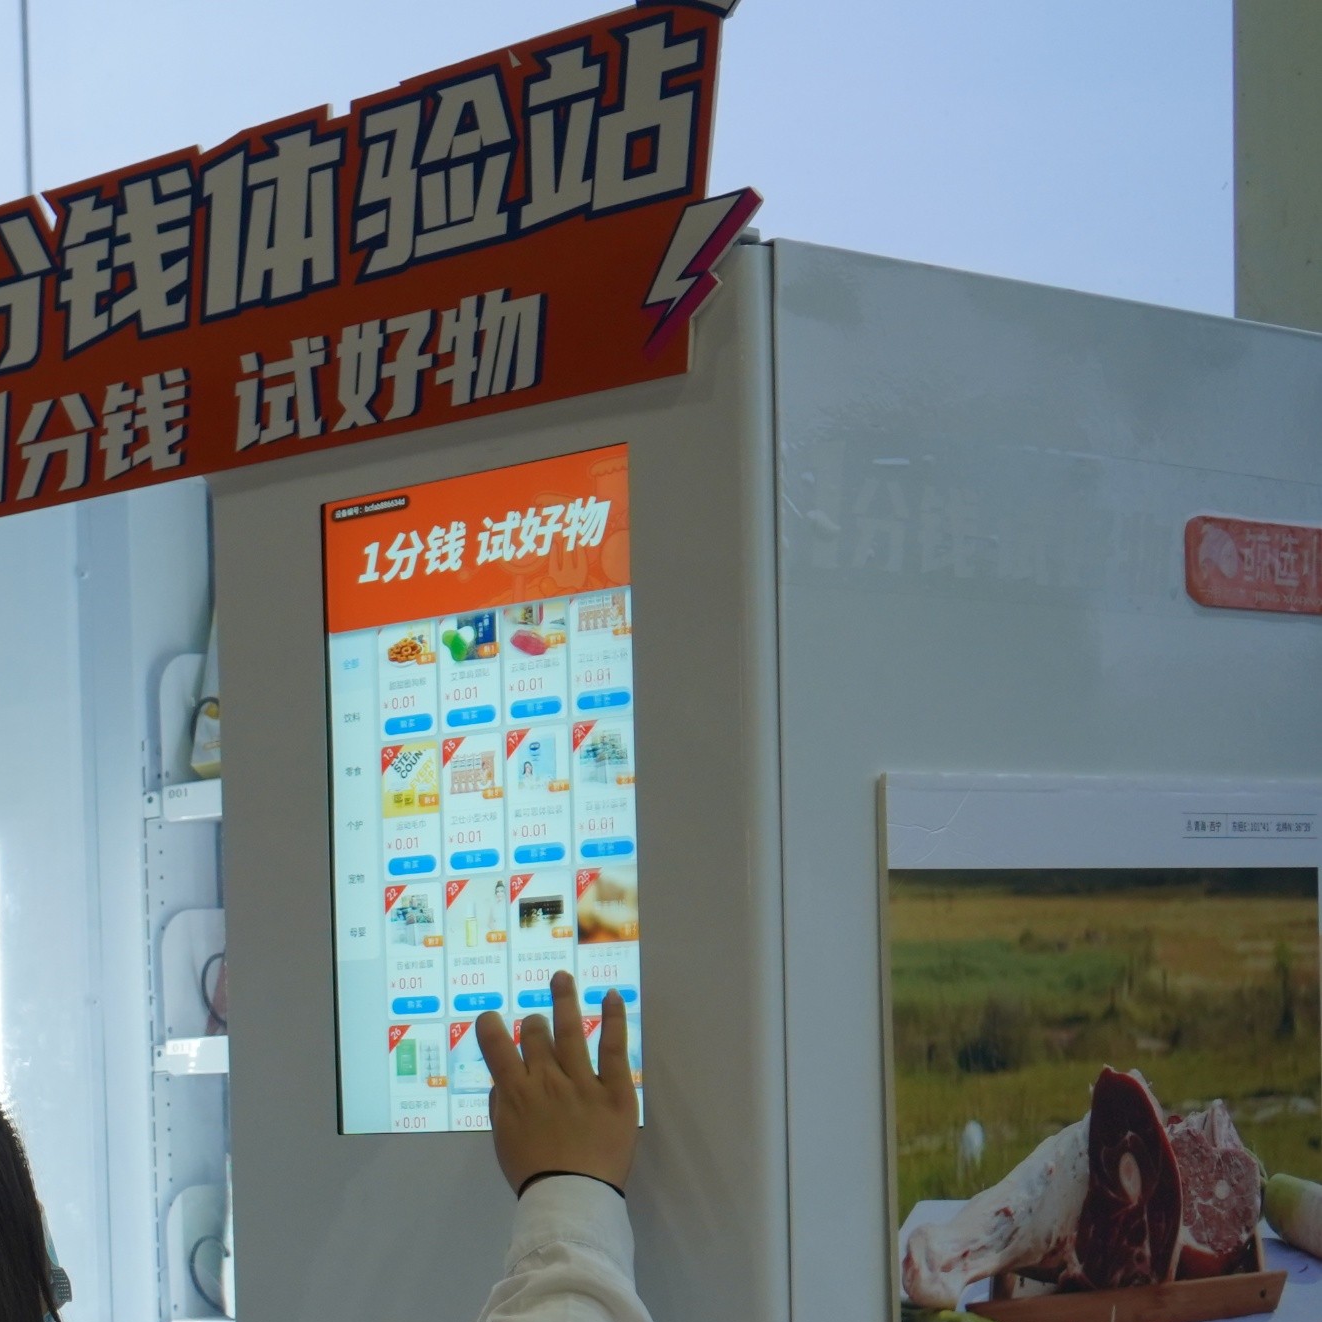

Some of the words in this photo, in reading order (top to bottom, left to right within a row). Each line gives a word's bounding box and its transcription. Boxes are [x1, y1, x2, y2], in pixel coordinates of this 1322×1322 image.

[236, 289, 543, 451] 试好物
[358, 521, 467, 584] 1分钱
[475, 496, 611, 566] 试好物
[444, 741, 456, 752] 15
[383, 749, 394, 760] 13
[448, 882, 460, 896] 23
[511, 876, 524, 890] 24
[386, 887, 398, 901] 22
[390, 1028, 402, 1040] 26
[451, 1023, 463, 1037] 27
